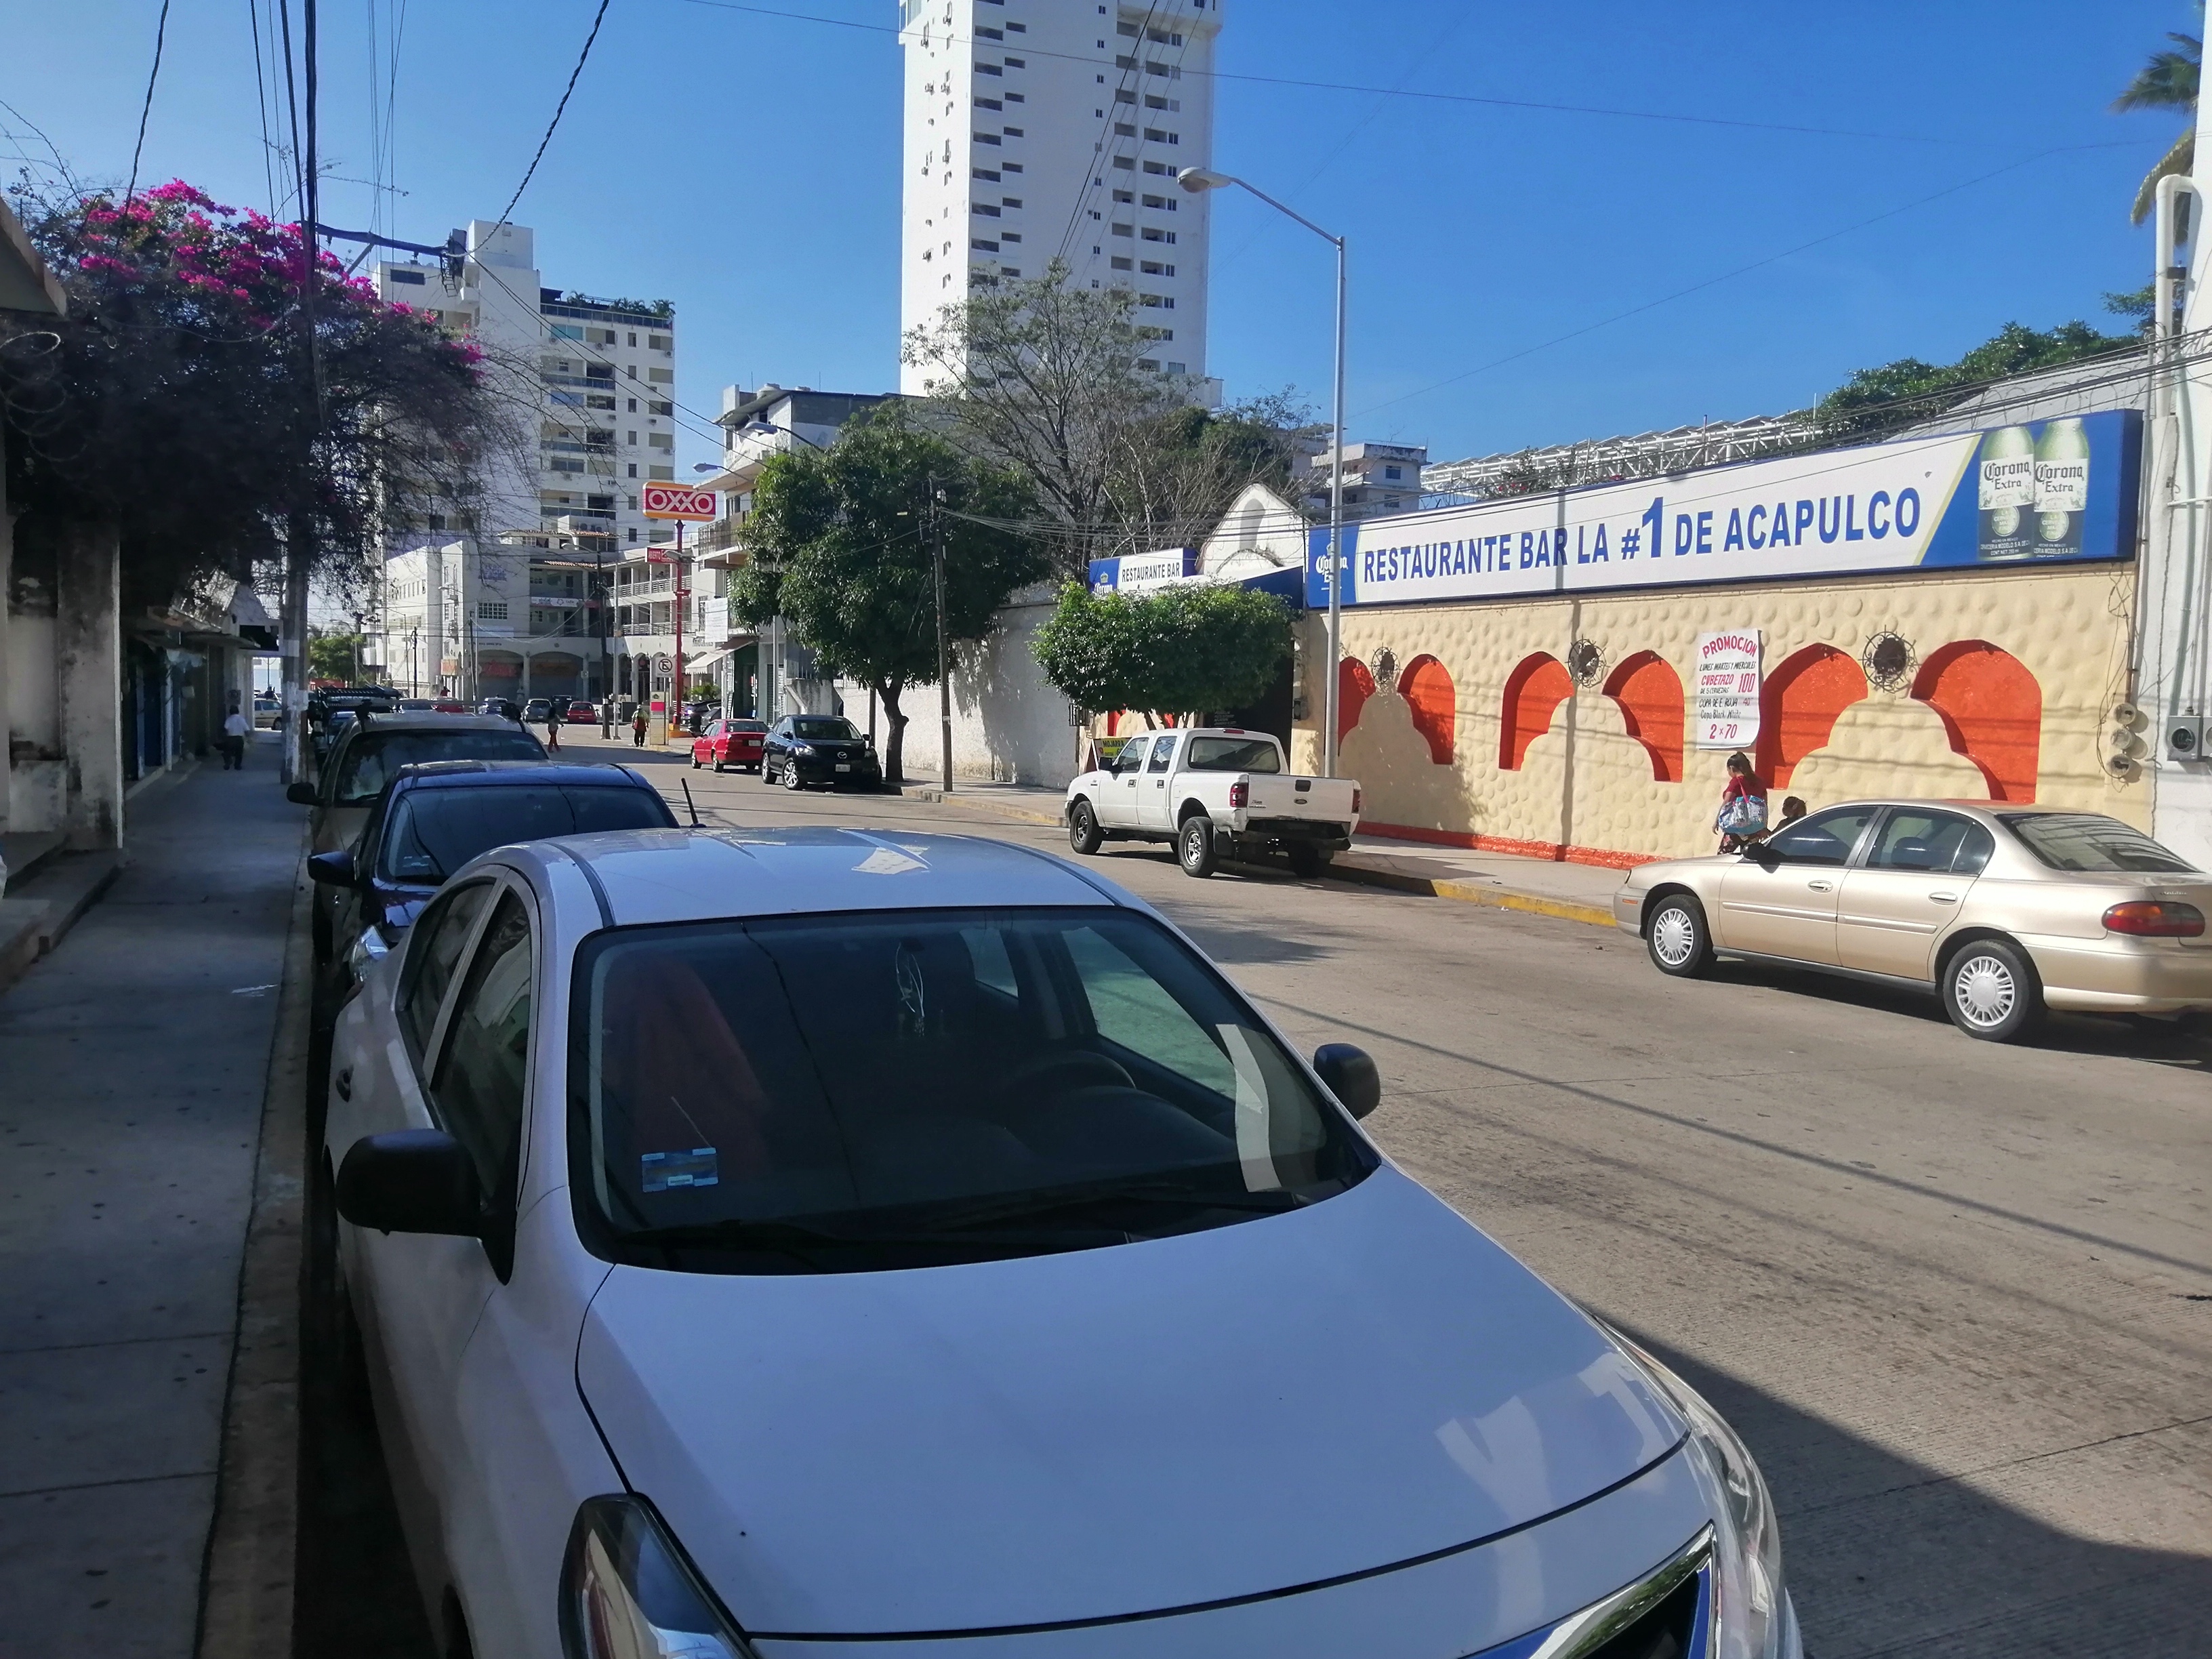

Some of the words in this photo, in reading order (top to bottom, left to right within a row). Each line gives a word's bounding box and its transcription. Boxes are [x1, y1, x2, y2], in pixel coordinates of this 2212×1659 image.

[1984, 462, 2031, 481] Corona
[2035, 464, 2084, 483] Corona
[1994, 478, 2022, 490] Extra
[2045, 481, 2073, 493] Extra
[648, 490, 714, 513] OXXO
[1364, 534, 1511, 583] RESTAURANTE
[1520, 527, 1568, 569] BAR
[1577, 523, 1609, 564] LA
[1621, 497, 1663, 560] #1
[1675, 510, 1713, 556] DE
[1723, 487, 1921, 552] ACAPULCO
[1122, 564, 1166, 583] RESTAURANTE
[1167, 562, 1180, 579] BAR
[1702, 635, 1757, 659] PROMOCION
[1734, 661, 1756, 670] MIERCOLES
[1701, 674, 1734, 686] CUBETAZO
[1738, 673, 1755, 693] 100
[1699, 699, 1711, 708] COPA
[1713, 698, 1719, 707] DE
[1725, 697, 1738, 707] ROJA
[1709, 724, 1717, 739] 2
[1725, 724, 1738, 739] 70
